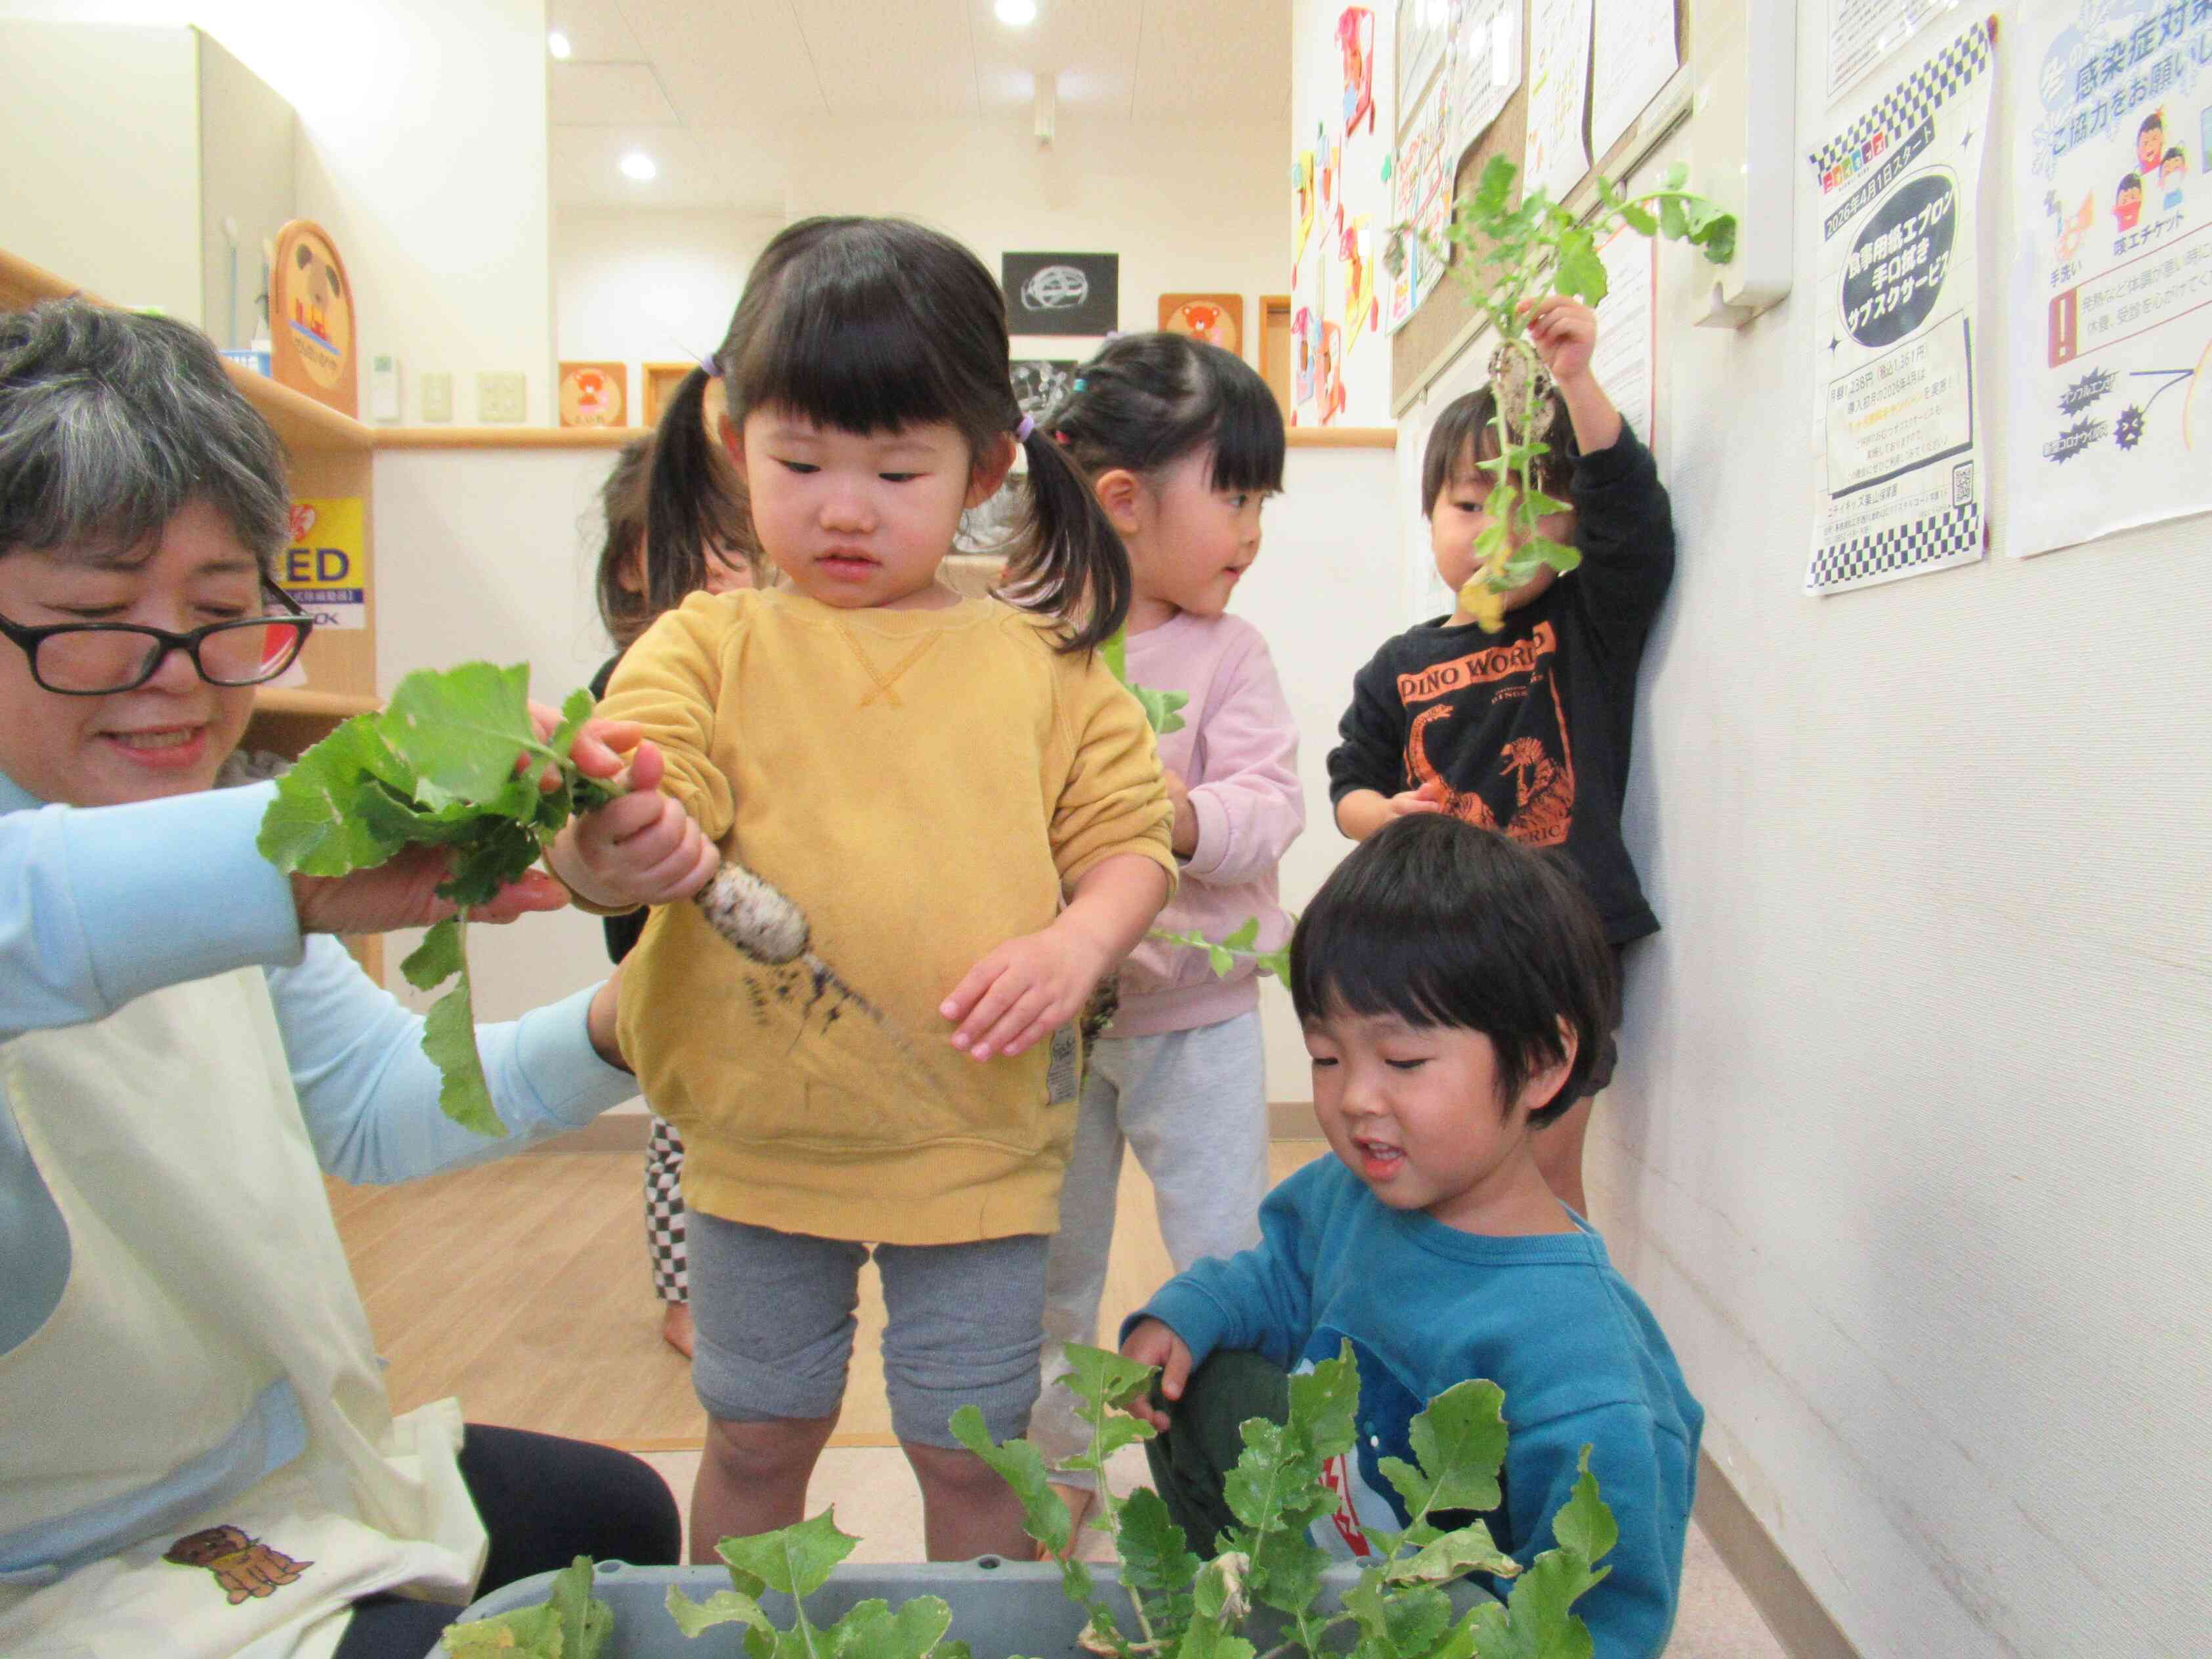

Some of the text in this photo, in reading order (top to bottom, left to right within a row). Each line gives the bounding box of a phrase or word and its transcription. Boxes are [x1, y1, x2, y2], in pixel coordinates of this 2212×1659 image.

[1827, 125, 1933, 237] 2026年4月1日スタート
[1848, 191, 1953, 280] 食事用紙エプロン
[1871, 237, 1930, 291] 手口拭き
[1848, 250, 1949, 334] サブスクサービス
[286, 547, 350, 583] ED
[1399, 667, 1460, 700] DINO
